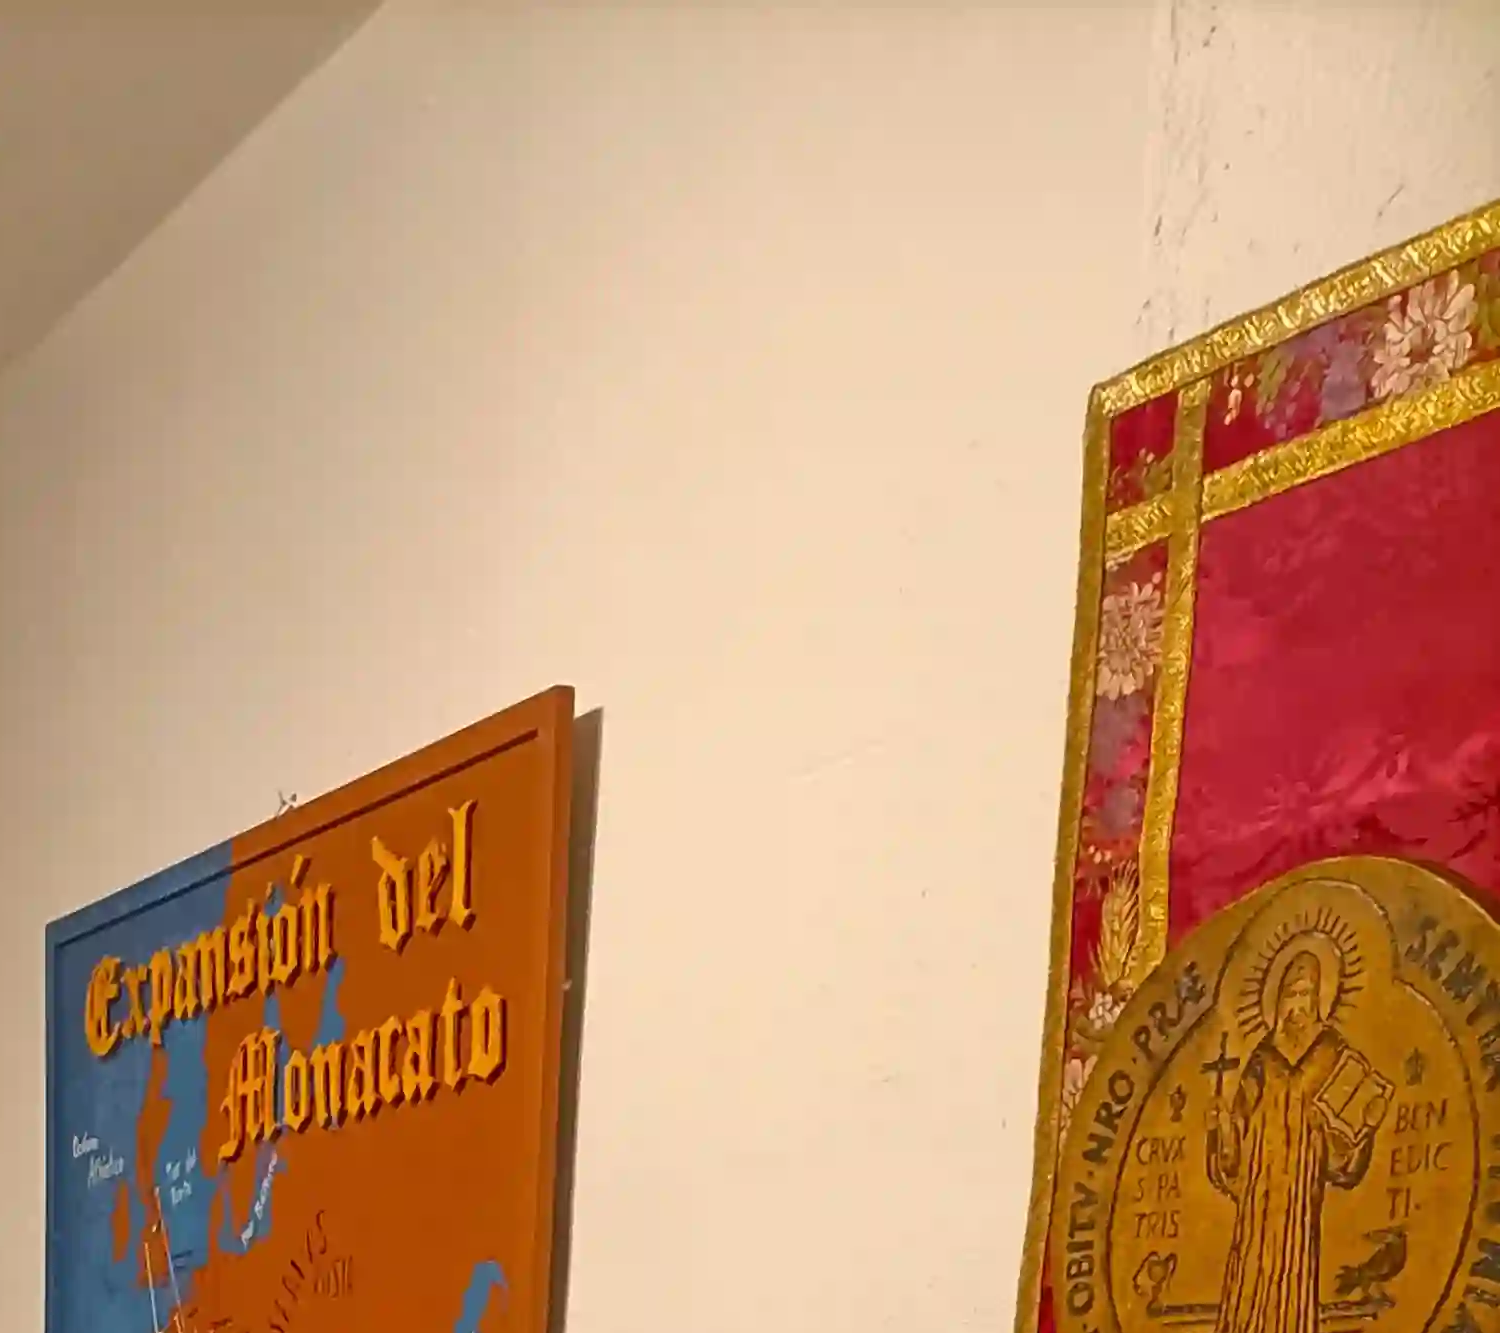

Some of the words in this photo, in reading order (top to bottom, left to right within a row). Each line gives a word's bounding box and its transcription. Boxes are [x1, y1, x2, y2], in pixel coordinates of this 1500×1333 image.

[84, 854, 339, 1058] Expansión
[371, 799, 478, 956] del
[218, 976, 508, 1163] Monacato
[1391, 1142, 1453, 1177] EDIC
[1135, 1210, 1181, 1239] TRIS
